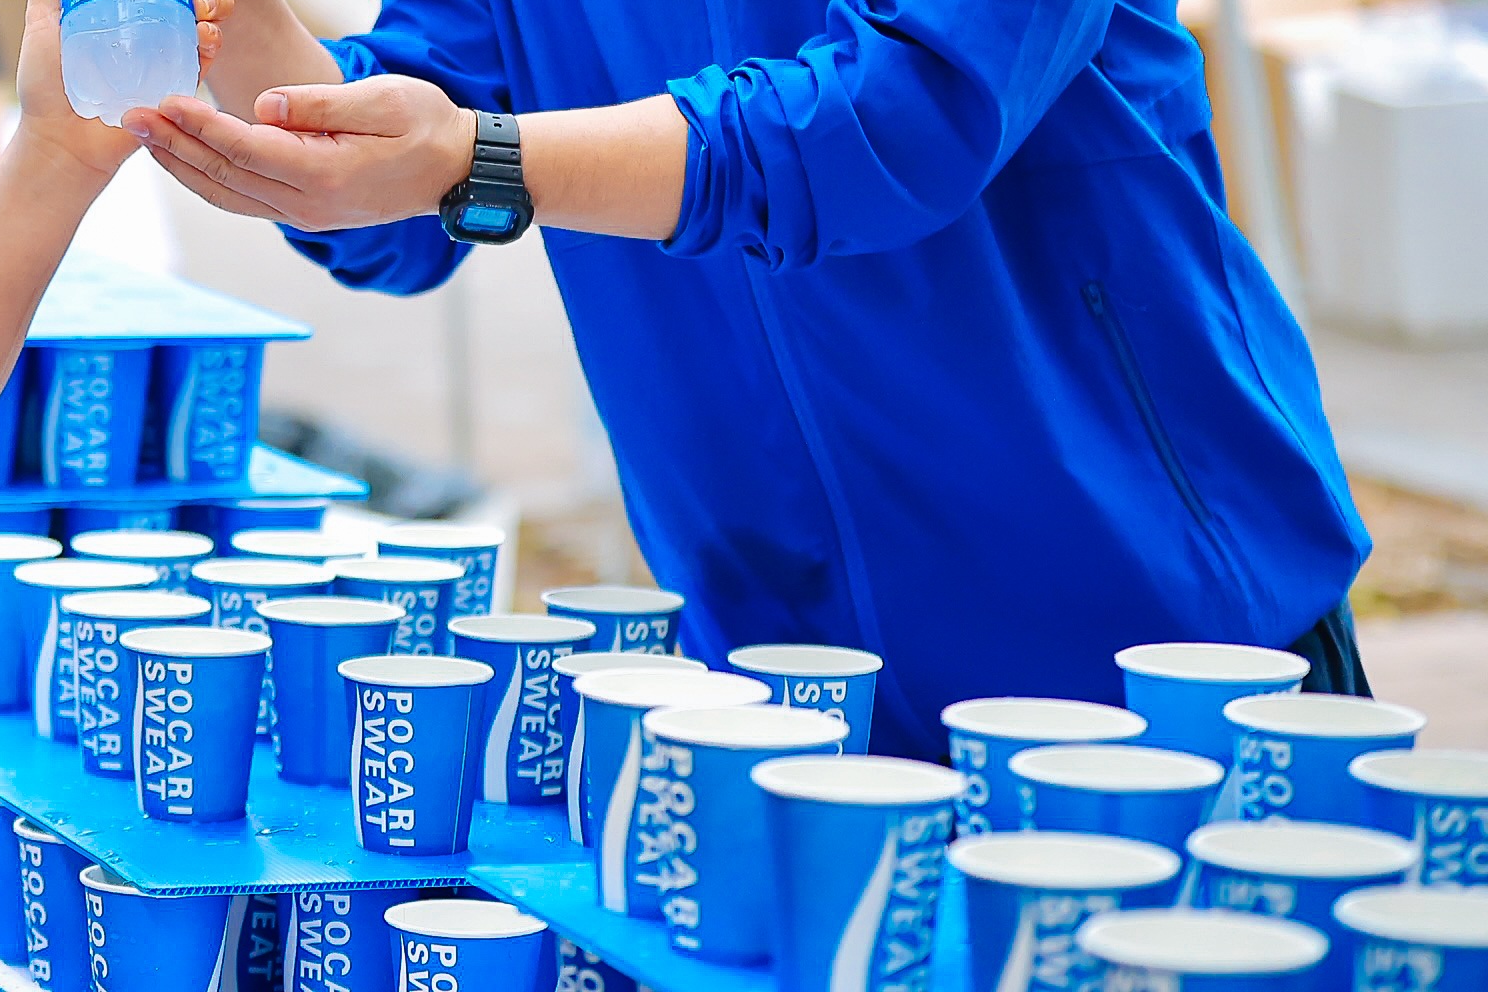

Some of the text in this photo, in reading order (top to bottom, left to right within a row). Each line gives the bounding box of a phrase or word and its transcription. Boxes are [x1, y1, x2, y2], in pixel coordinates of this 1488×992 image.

[77, 620, 99, 757] SWEAT
[95, 622, 123, 771] POCARI
[145, 660, 167, 801] SWEAT
[167, 662, 194, 815] POCARI
[518, 649, 552, 786] SWEAT
[363, 689, 387, 833] SWEAT
[388, 692, 415, 847] POCARI
